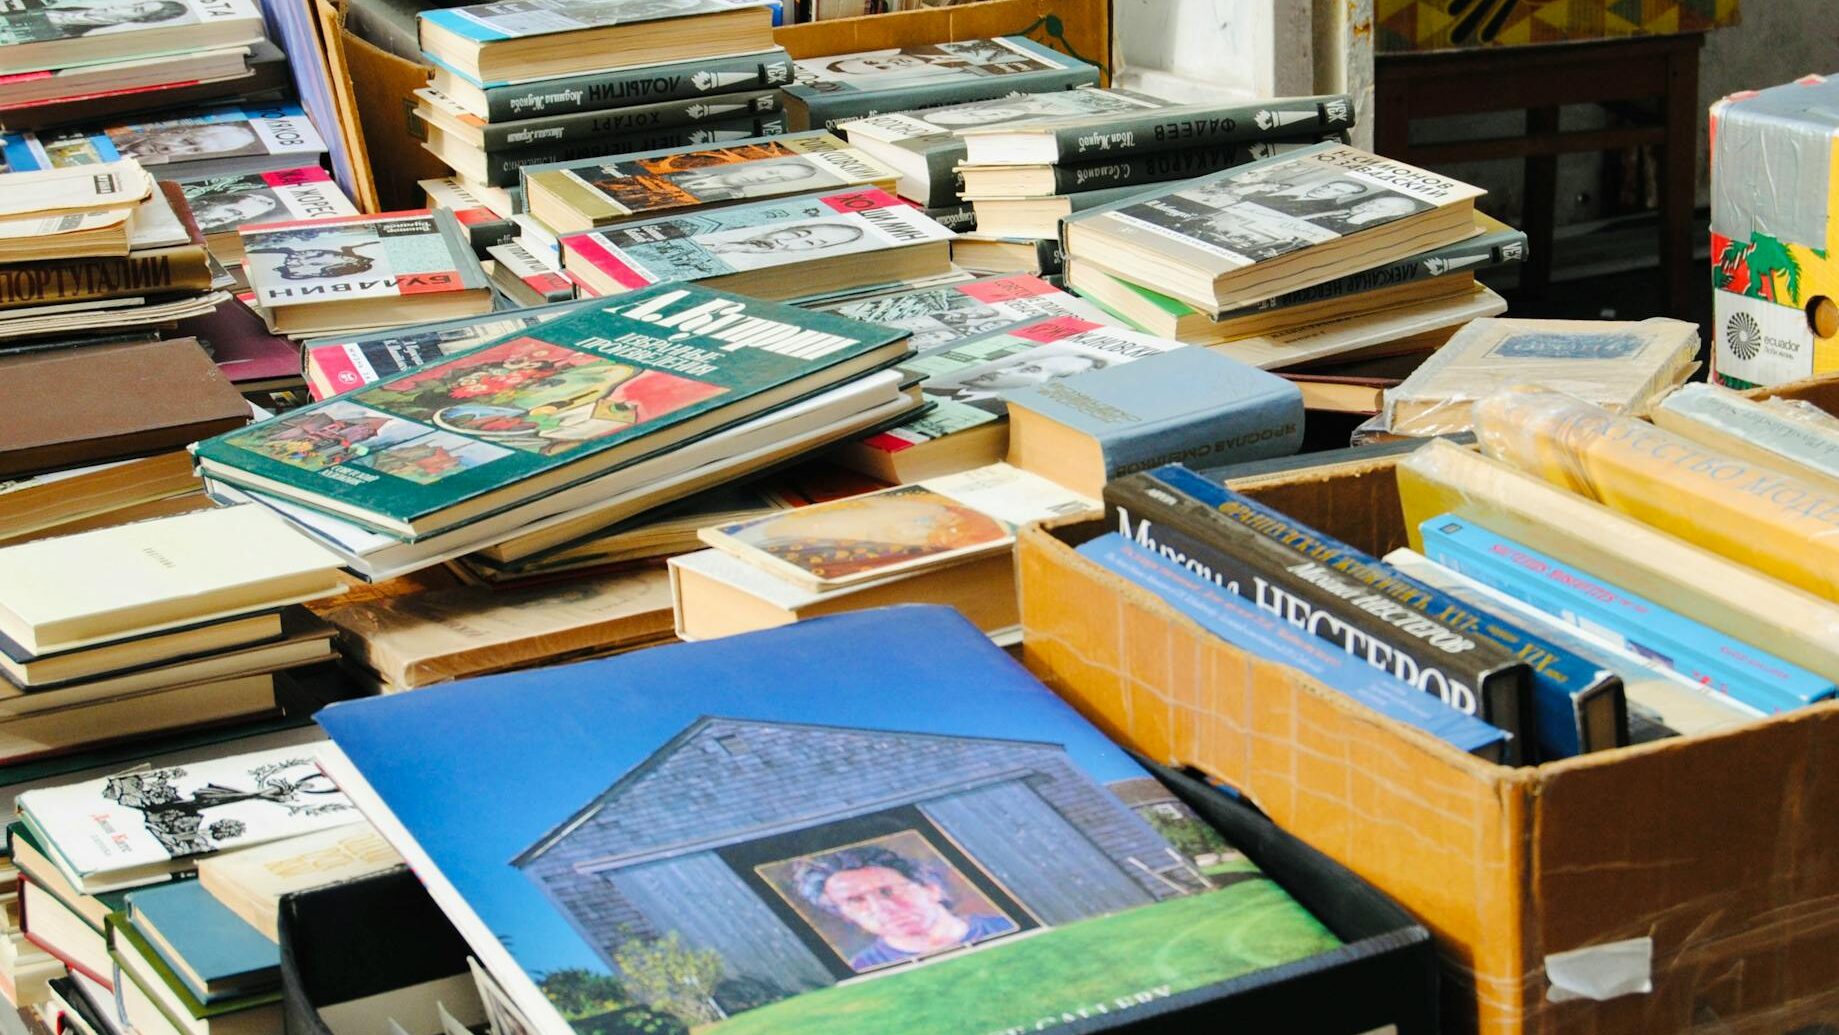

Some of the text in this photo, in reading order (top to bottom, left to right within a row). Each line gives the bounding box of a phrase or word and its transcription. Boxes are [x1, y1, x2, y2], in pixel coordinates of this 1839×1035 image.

[587, 74, 681, 99] ЛОДЫГИН
[591, 110, 661, 133] ХОГАРТ
[1154, 117, 1236, 143] ФАДЕЕВ
[1334, 161, 1448, 199] ЗАВАДСКИЙ
[1352, 156, 1454, 190] СИМОНОВ
[289, 187, 339, 217] ЖОРЕС
[834, 193, 930, 241] ХО ШИ МИН
[268, 274, 453, 299] БУЛАВИН
[1347, 260, 1419, 296] АЛЕКСАНДР
[1764, 336, 1801, 353] ecuador
[1351, 593, 1476, 654] НЕСТЕРОВ
[1252, 575, 1478, 717] НЕСТЕРОВ
